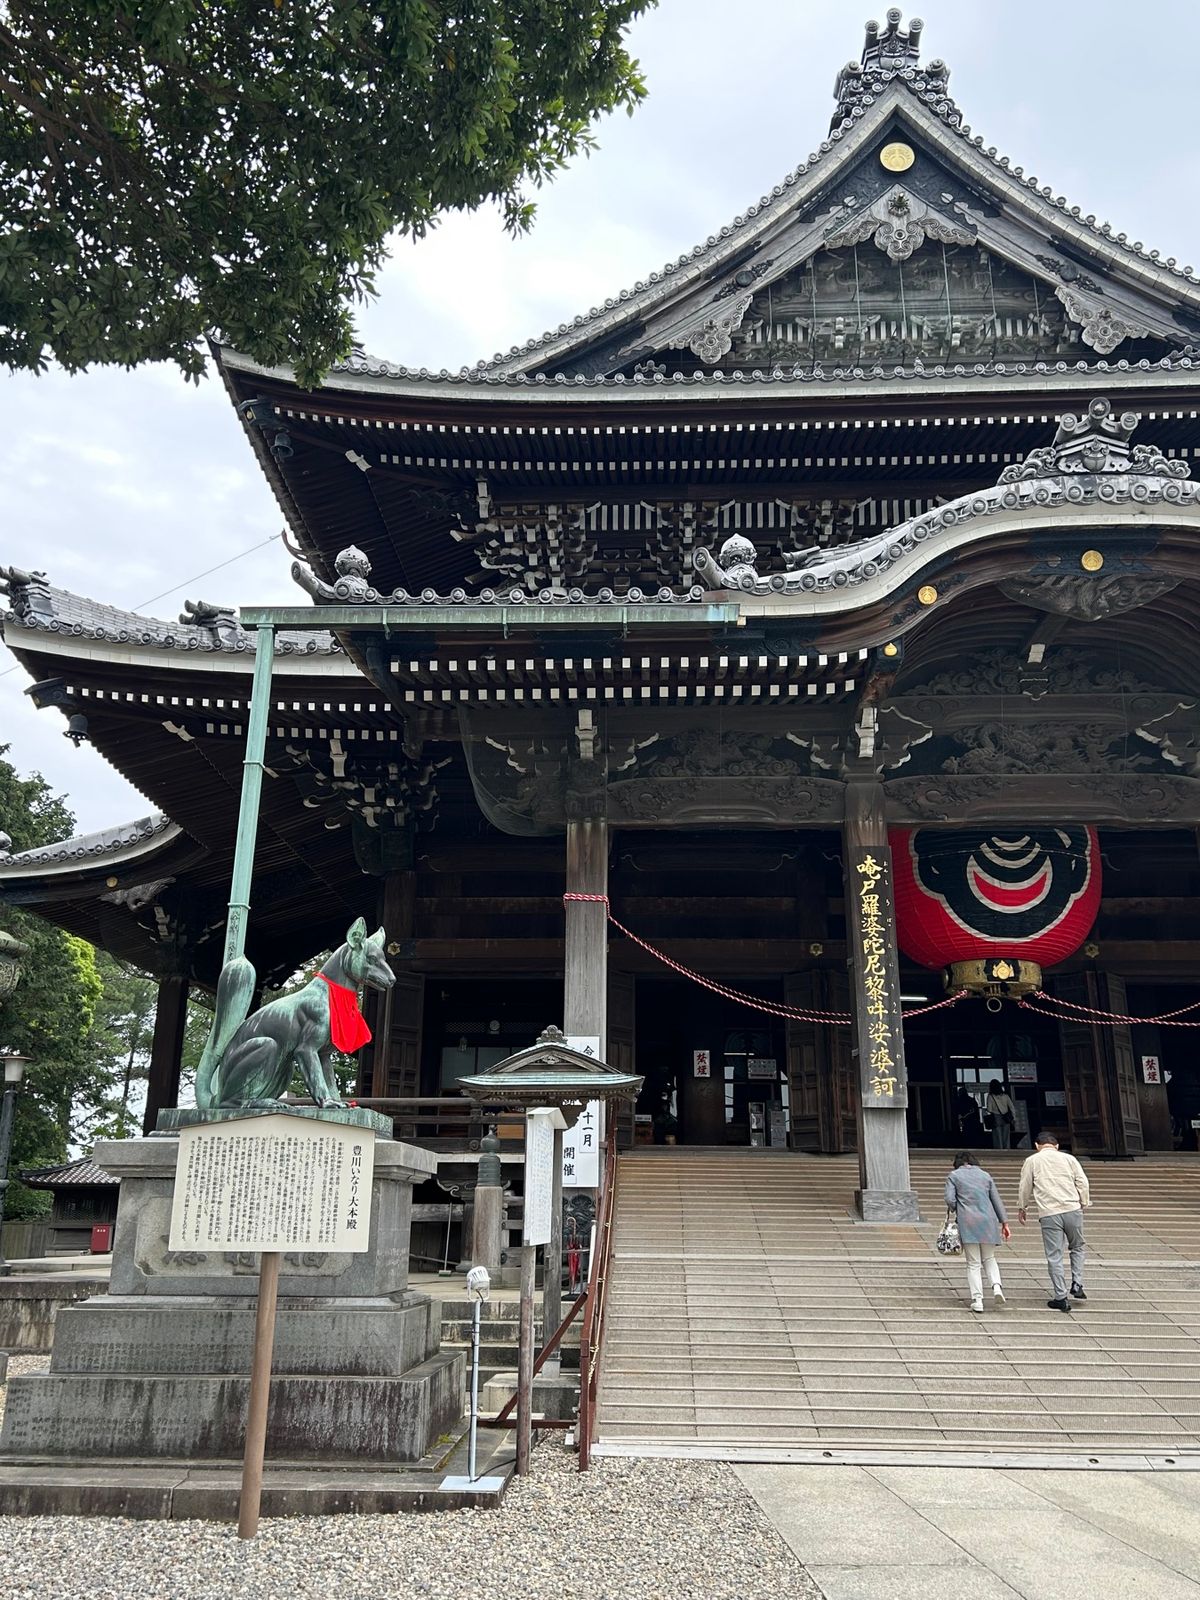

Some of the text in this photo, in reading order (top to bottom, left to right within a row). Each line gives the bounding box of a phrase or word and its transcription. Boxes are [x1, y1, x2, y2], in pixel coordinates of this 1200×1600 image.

[696, 1052, 707, 1075] 禁煙
[1145, 1058, 1158, 1082] 禁煙
[582, 1112, 594, 1147] 十一月
[563, 1147, 575, 1176] 開催
[346, 1145, 362, 1230] 豊川いなり大本殿
